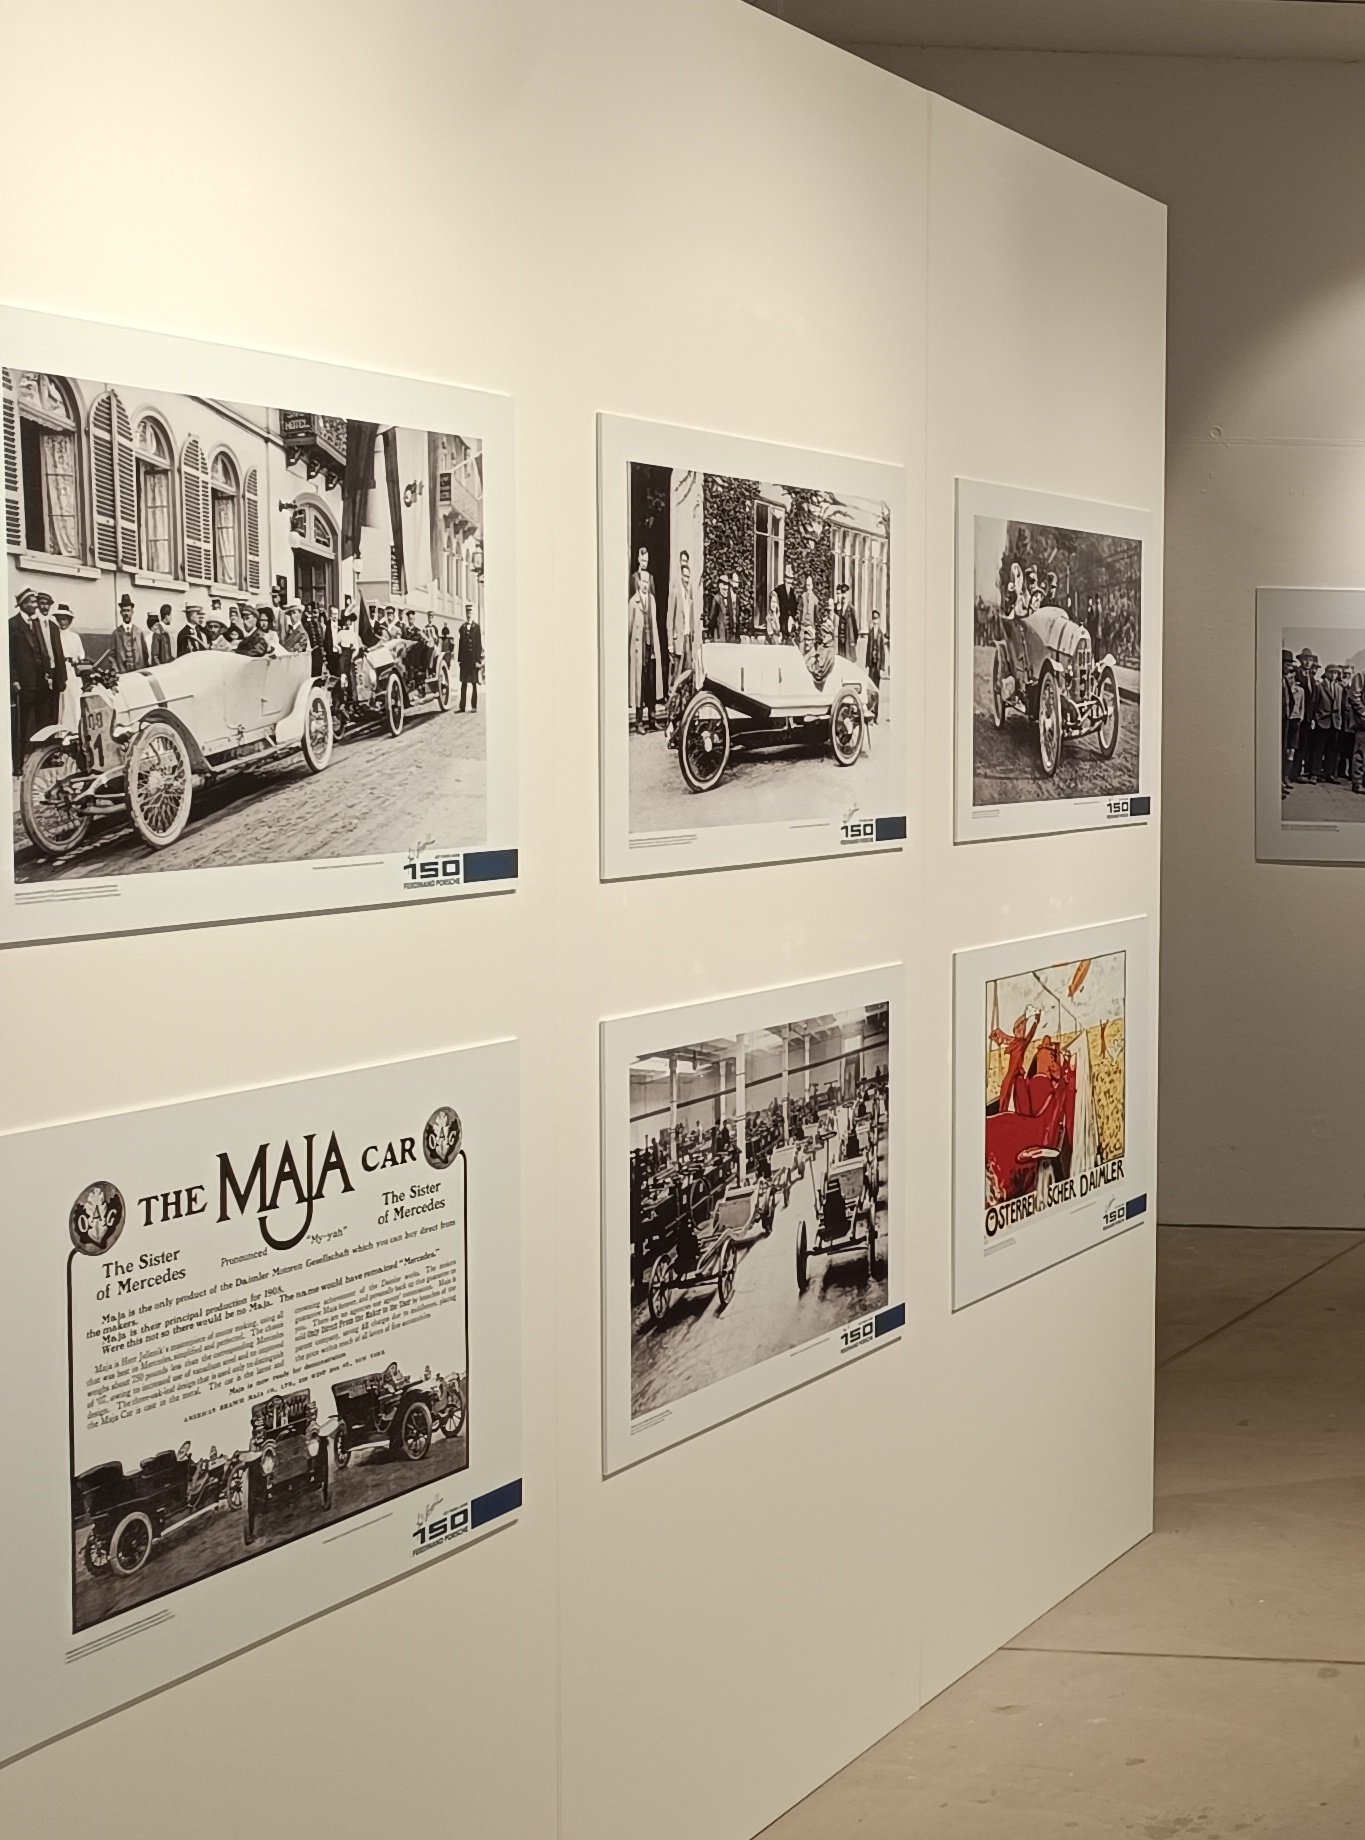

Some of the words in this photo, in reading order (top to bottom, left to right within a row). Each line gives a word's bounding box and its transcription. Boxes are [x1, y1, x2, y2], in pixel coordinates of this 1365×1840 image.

[1107, 802, 1128, 813] 150
[841, 824, 873, 838] 150
[403, 860, 460, 880] 150
[137, 1185, 207, 1226] THE
[216, 1131, 355, 1250] MAJA
[361, 1137, 416, 1172] CAR
[1080, 1160, 1125, 1197] DAIMLER
[381, 1190, 405, 1205] The
[409, 1182, 441, 1198] Sister
[377, 1209, 389, 1225] of
[393, 1197, 445, 1221] Mercedes
[1103, 1207, 1125, 1224] 150
[101, 1260, 134, 1278] The
[138, 1249, 180, 1269] Sister
[220, 1246, 267, 1267] Pronounced
[95, 1283, 111, 1300] of
[117, 1267, 186, 1295] Mercedes
[127, 1308, 135, 1317] is
[138, 1303, 152, 1314] the
[153, 1297, 173, 1309] only
[175, 1289, 206, 1304] product
[209, 1284, 217, 1294] of
[219, 1281, 233, 1291] the
[235, 1271, 269, 1287] Daimler
[101, 1341, 124, 1354] Were
[126, 1337, 143, 1348] this
[145, 1332, 159, 1342] not
[160, 1326, 170, 1338] so
[172, 1319, 194, 1334] there
[195, 1312, 222, 1326] would
[224, 1310, 234, 1319] be
[235, 1307, 246, 1316] no
[278, 1293, 294, 1303] The
[295, 1286, 319, 1298] name
[320, 1276, 342, 1290] would
[129, 1328, 137, 1336] is
[140, 1322, 161, 1333] their
[164, 1307, 202, 1327] principal
[205, 1297, 247, 1315] production
[86, 1328, 101, 1339] the
[841, 1322, 873, 1345] 150
[413, 1508, 468, 1544] 150
